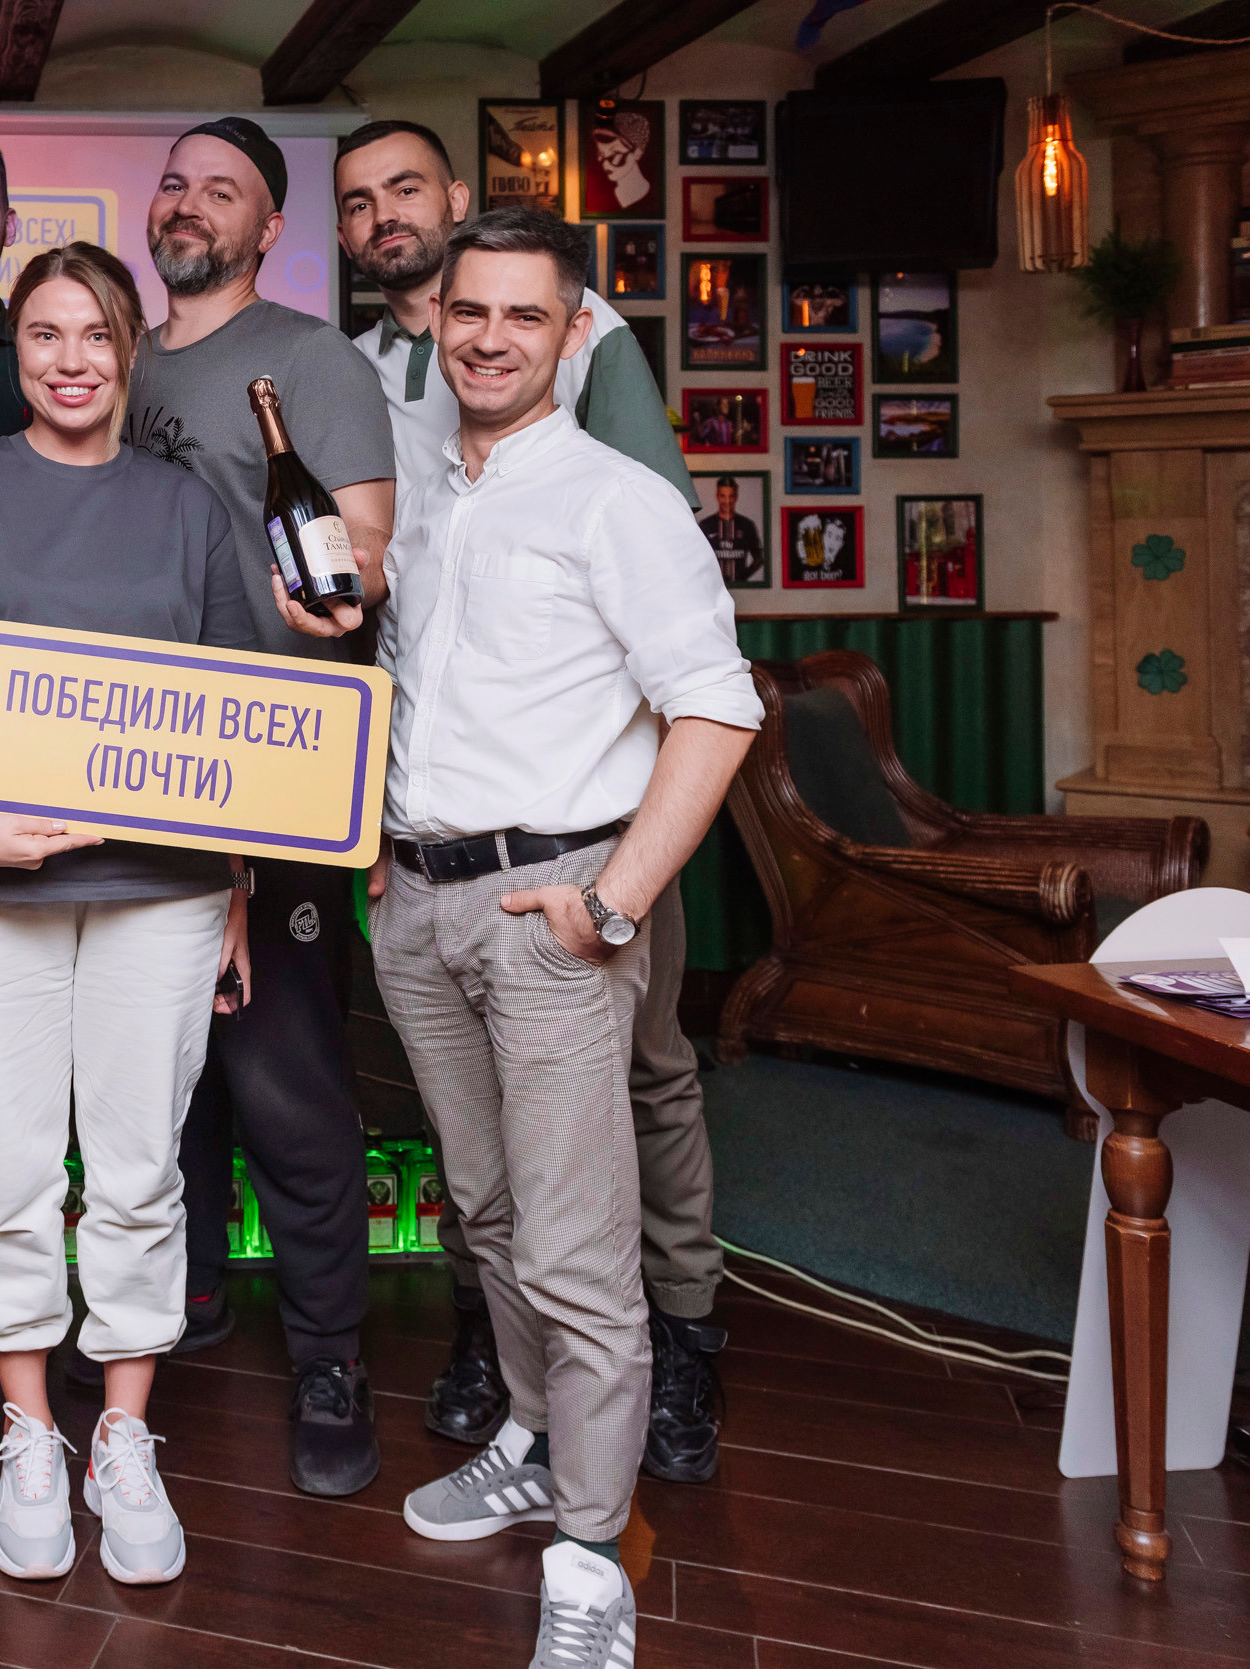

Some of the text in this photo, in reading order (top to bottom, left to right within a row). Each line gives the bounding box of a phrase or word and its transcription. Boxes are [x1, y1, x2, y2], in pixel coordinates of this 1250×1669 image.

[791, 350, 853, 361] DRINK
[790, 362, 854, 376] GOOD
[816, 376, 853, 388] BEER
[814, 398, 855, 409] GOOD
[814, 408, 855, 419] FRIENDS
[5, 669, 323, 751] ПОБЕДИЛИ ВСЕХ!
[85, 742, 233, 809] (ПОЧТИ)
[577, 1558, 605, 1577] adidas
